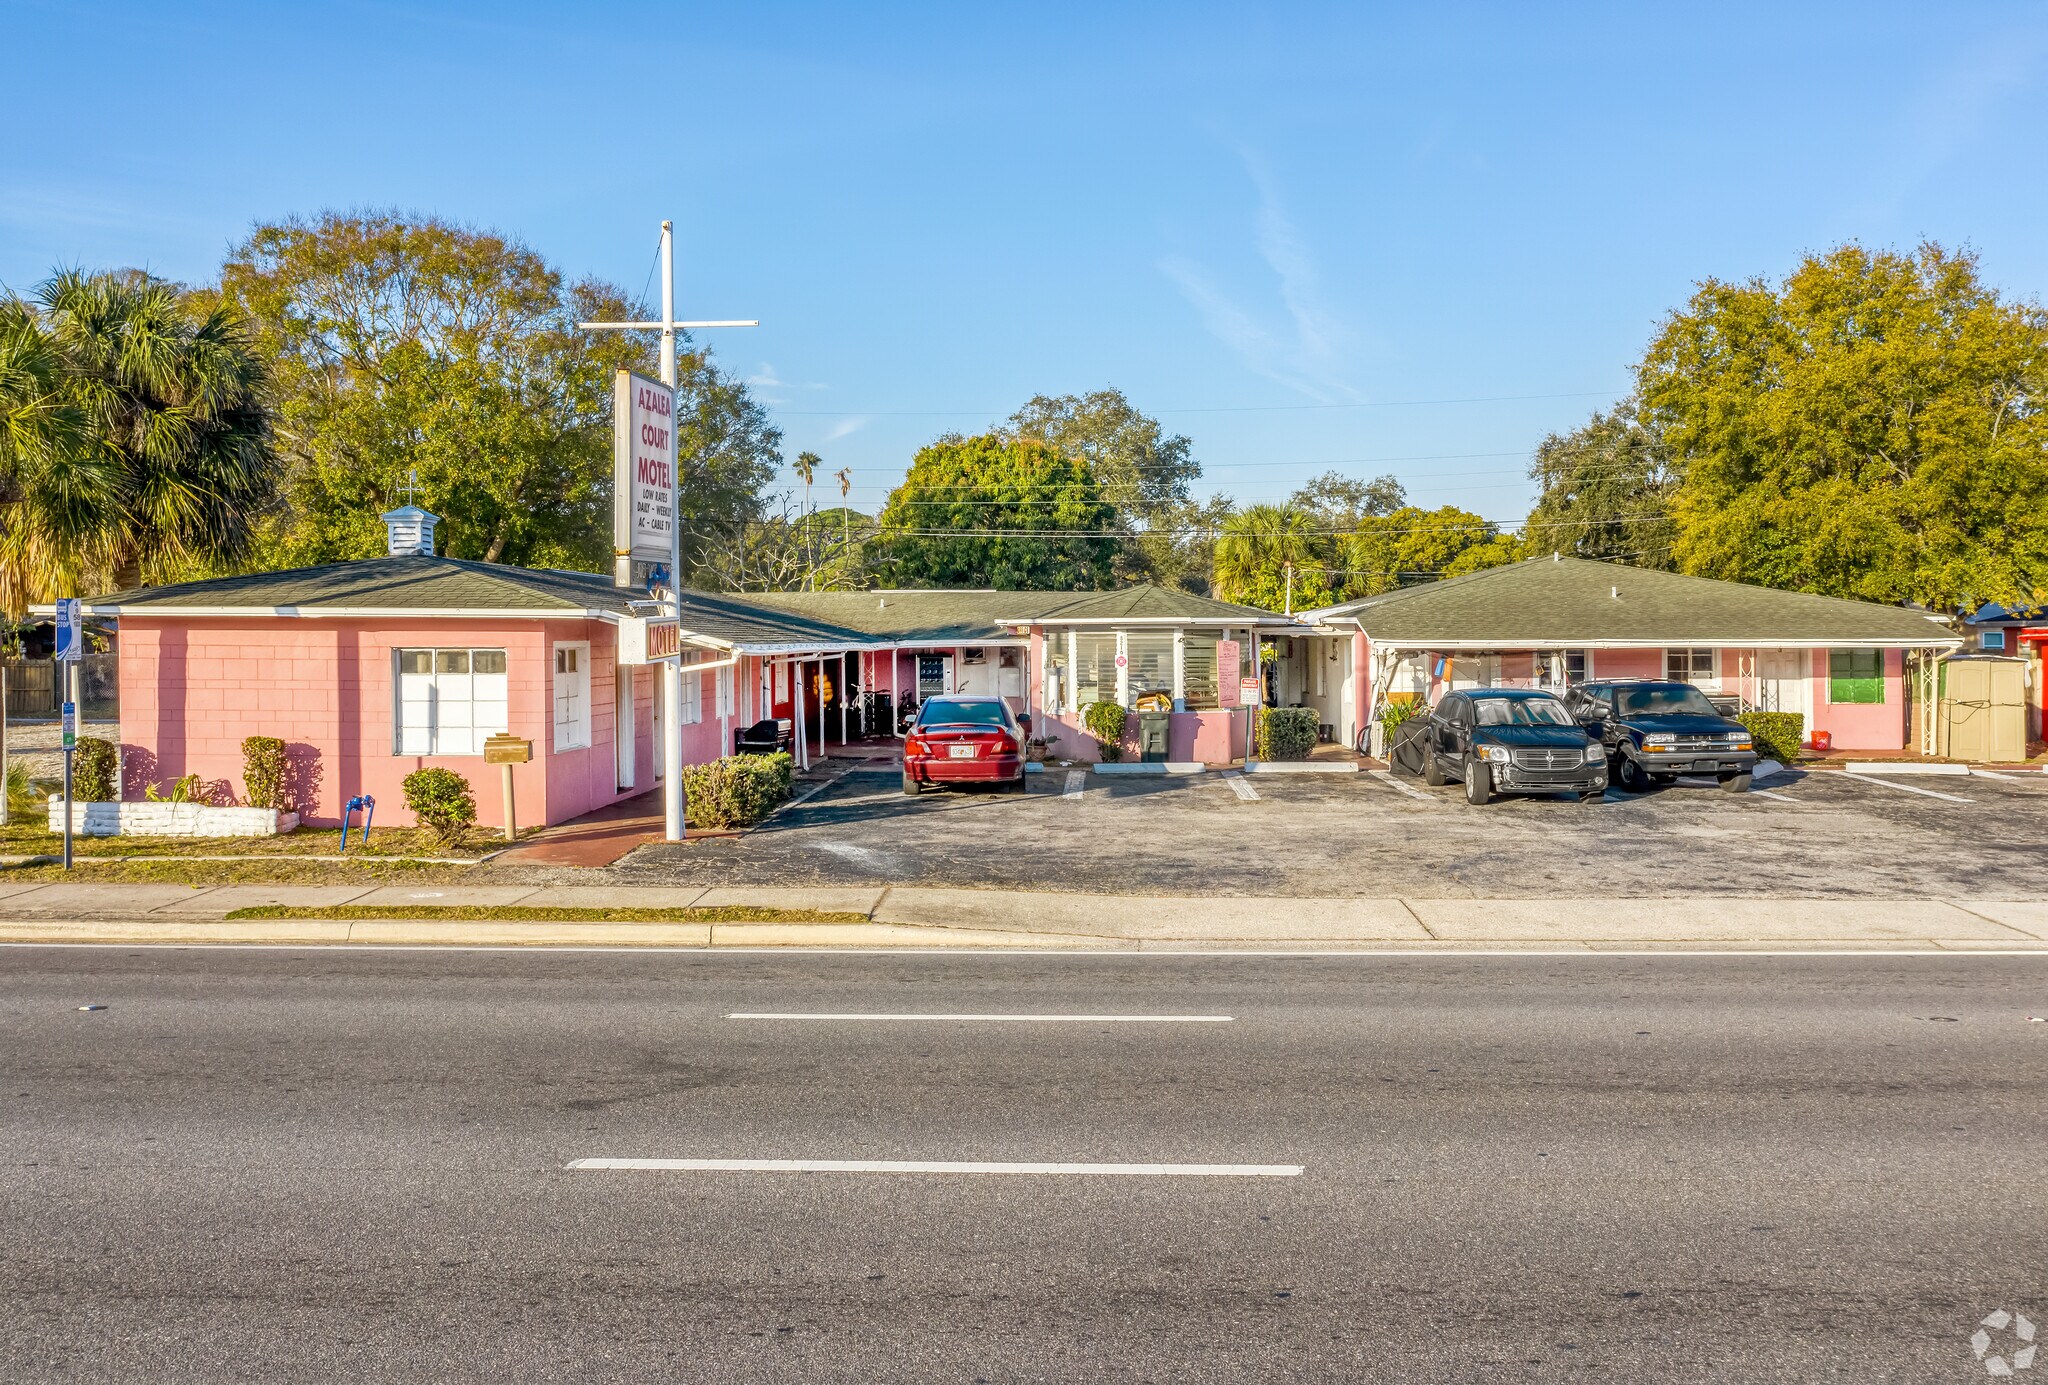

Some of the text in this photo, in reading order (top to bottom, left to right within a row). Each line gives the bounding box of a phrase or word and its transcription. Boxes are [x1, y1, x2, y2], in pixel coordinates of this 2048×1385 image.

[638, 387, 671, 418] AZALEA
[641, 423, 669, 451] COURT
[637, 456, 672, 489] MOTEL
[637, 501, 650, 513] DAILY
[656, 504, 672, 517] WEEKLY
[643, 488, 668, 504] LOW RATES
[638, 516, 645, 528] AC
[651, 518, 664, 531] CABLE
[665, 520, 671, 532] TV
[649, 623, 679, 657] MOTEL
